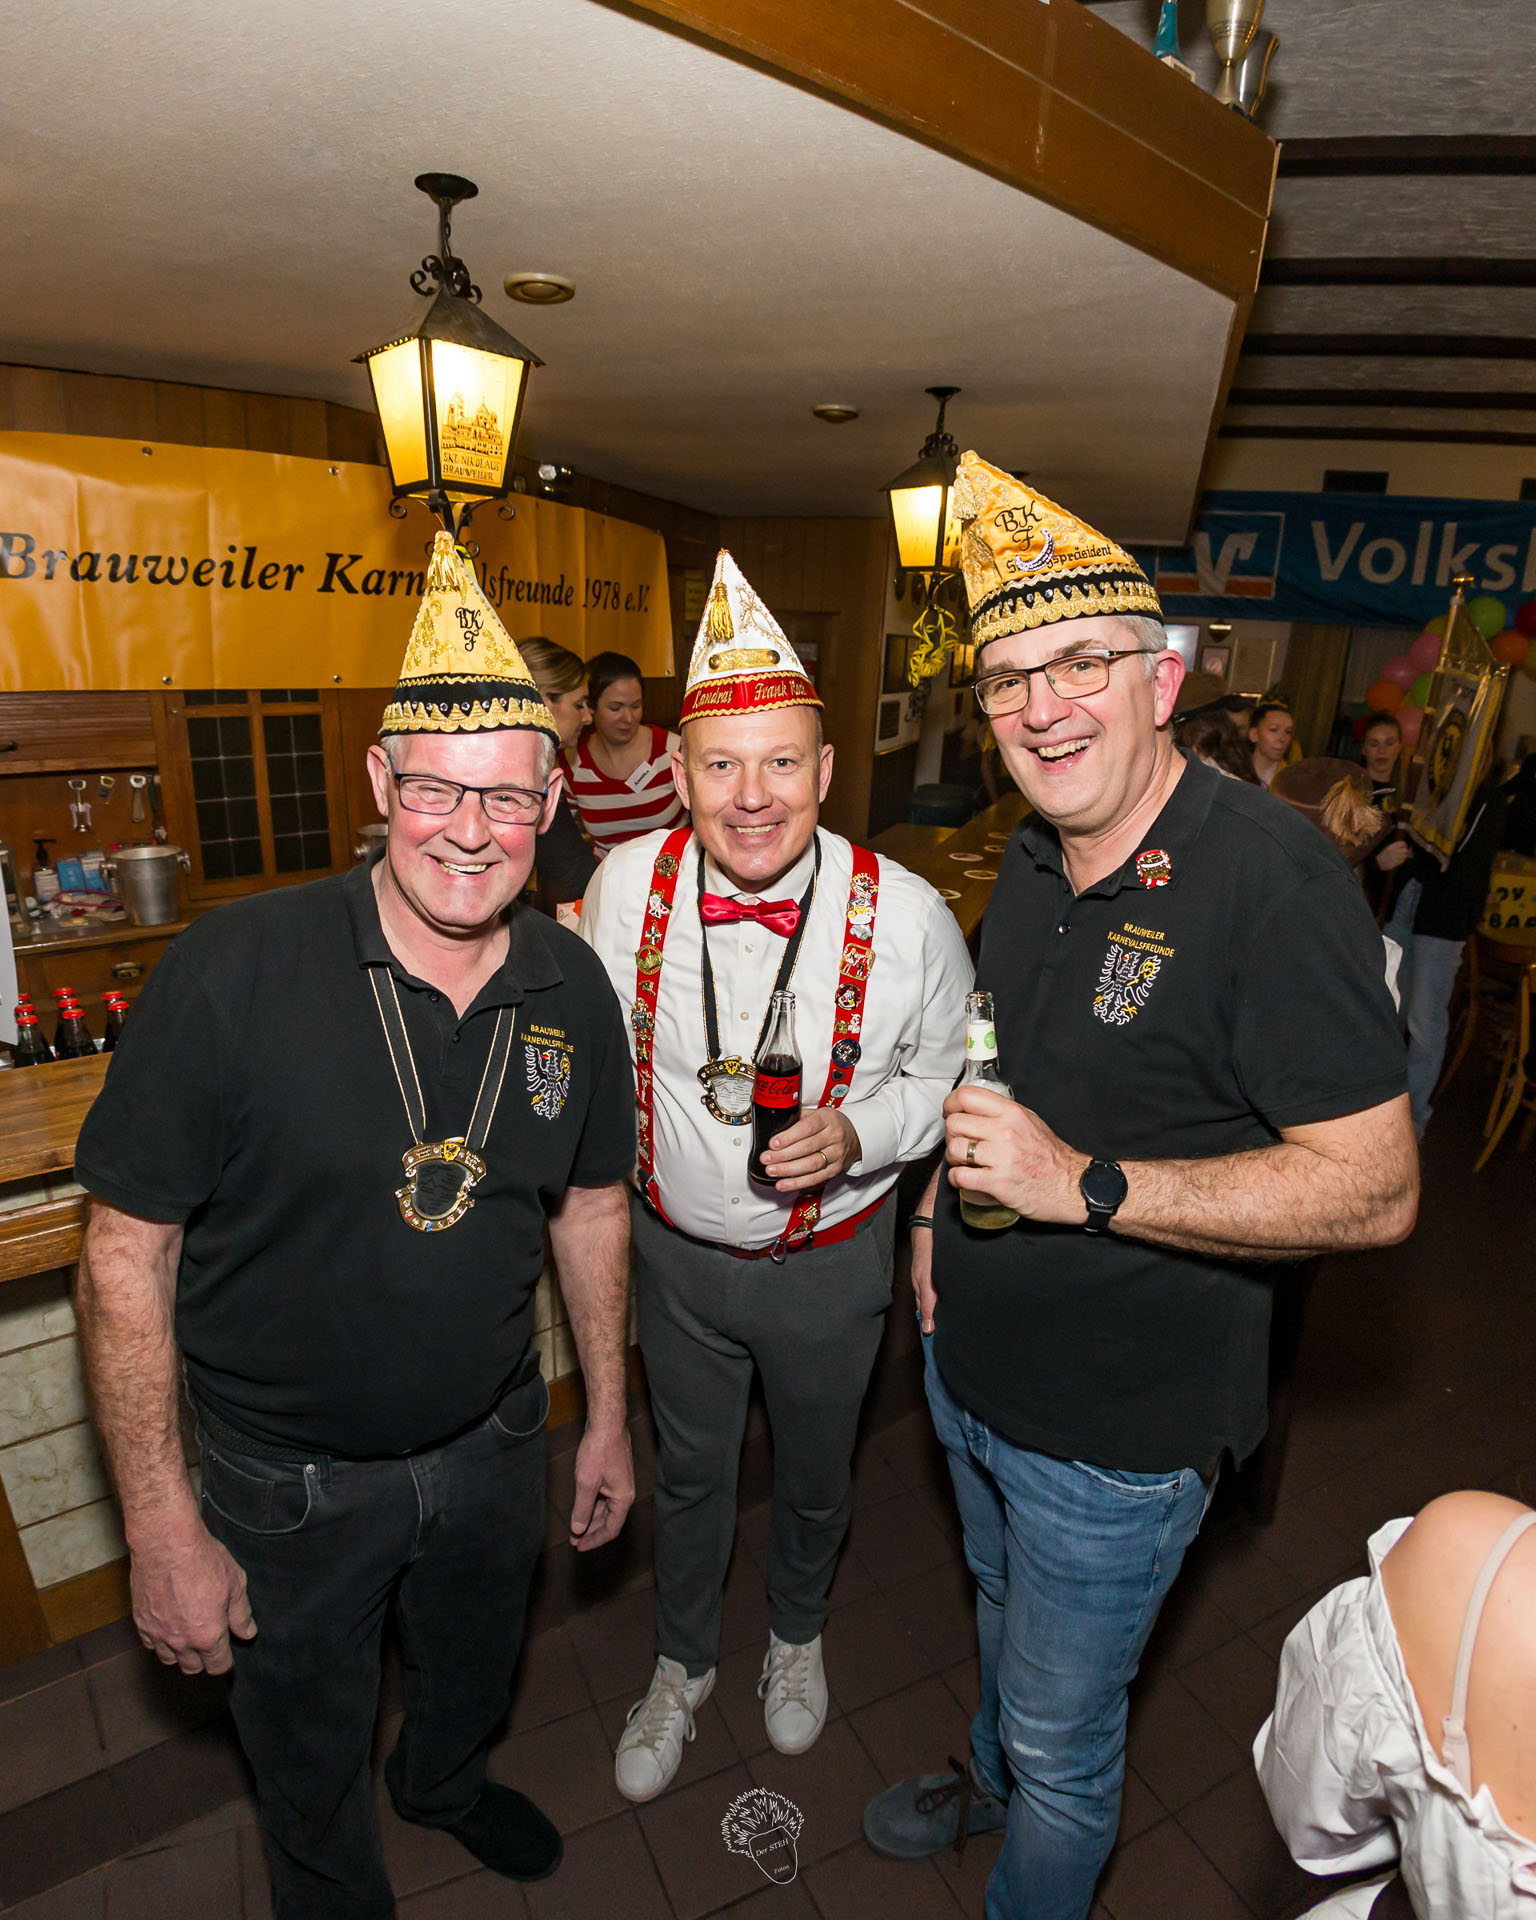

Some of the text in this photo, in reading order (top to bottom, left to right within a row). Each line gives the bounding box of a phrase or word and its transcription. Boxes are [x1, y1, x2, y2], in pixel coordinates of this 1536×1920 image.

[443, 464, 493, 480] BRAUWEILER
[1006, 545, 1111, 573] Sgspräsident
[0, 531, 304, 591] Brauweiler
[317, 552, 574, 609] Karnlsfreunde
[583, 577, 621, 610] 1978
[624, 580, 650, 613] e.V.
[754, 682, 788, 701] Frank
[1124, 923, 1165, 940] BRAUWEILER
[1108, 932, 1175, 957] KARNEVALSFREUNDE
[521, 1033, 574, 1052] KARNEVALSFREDE
